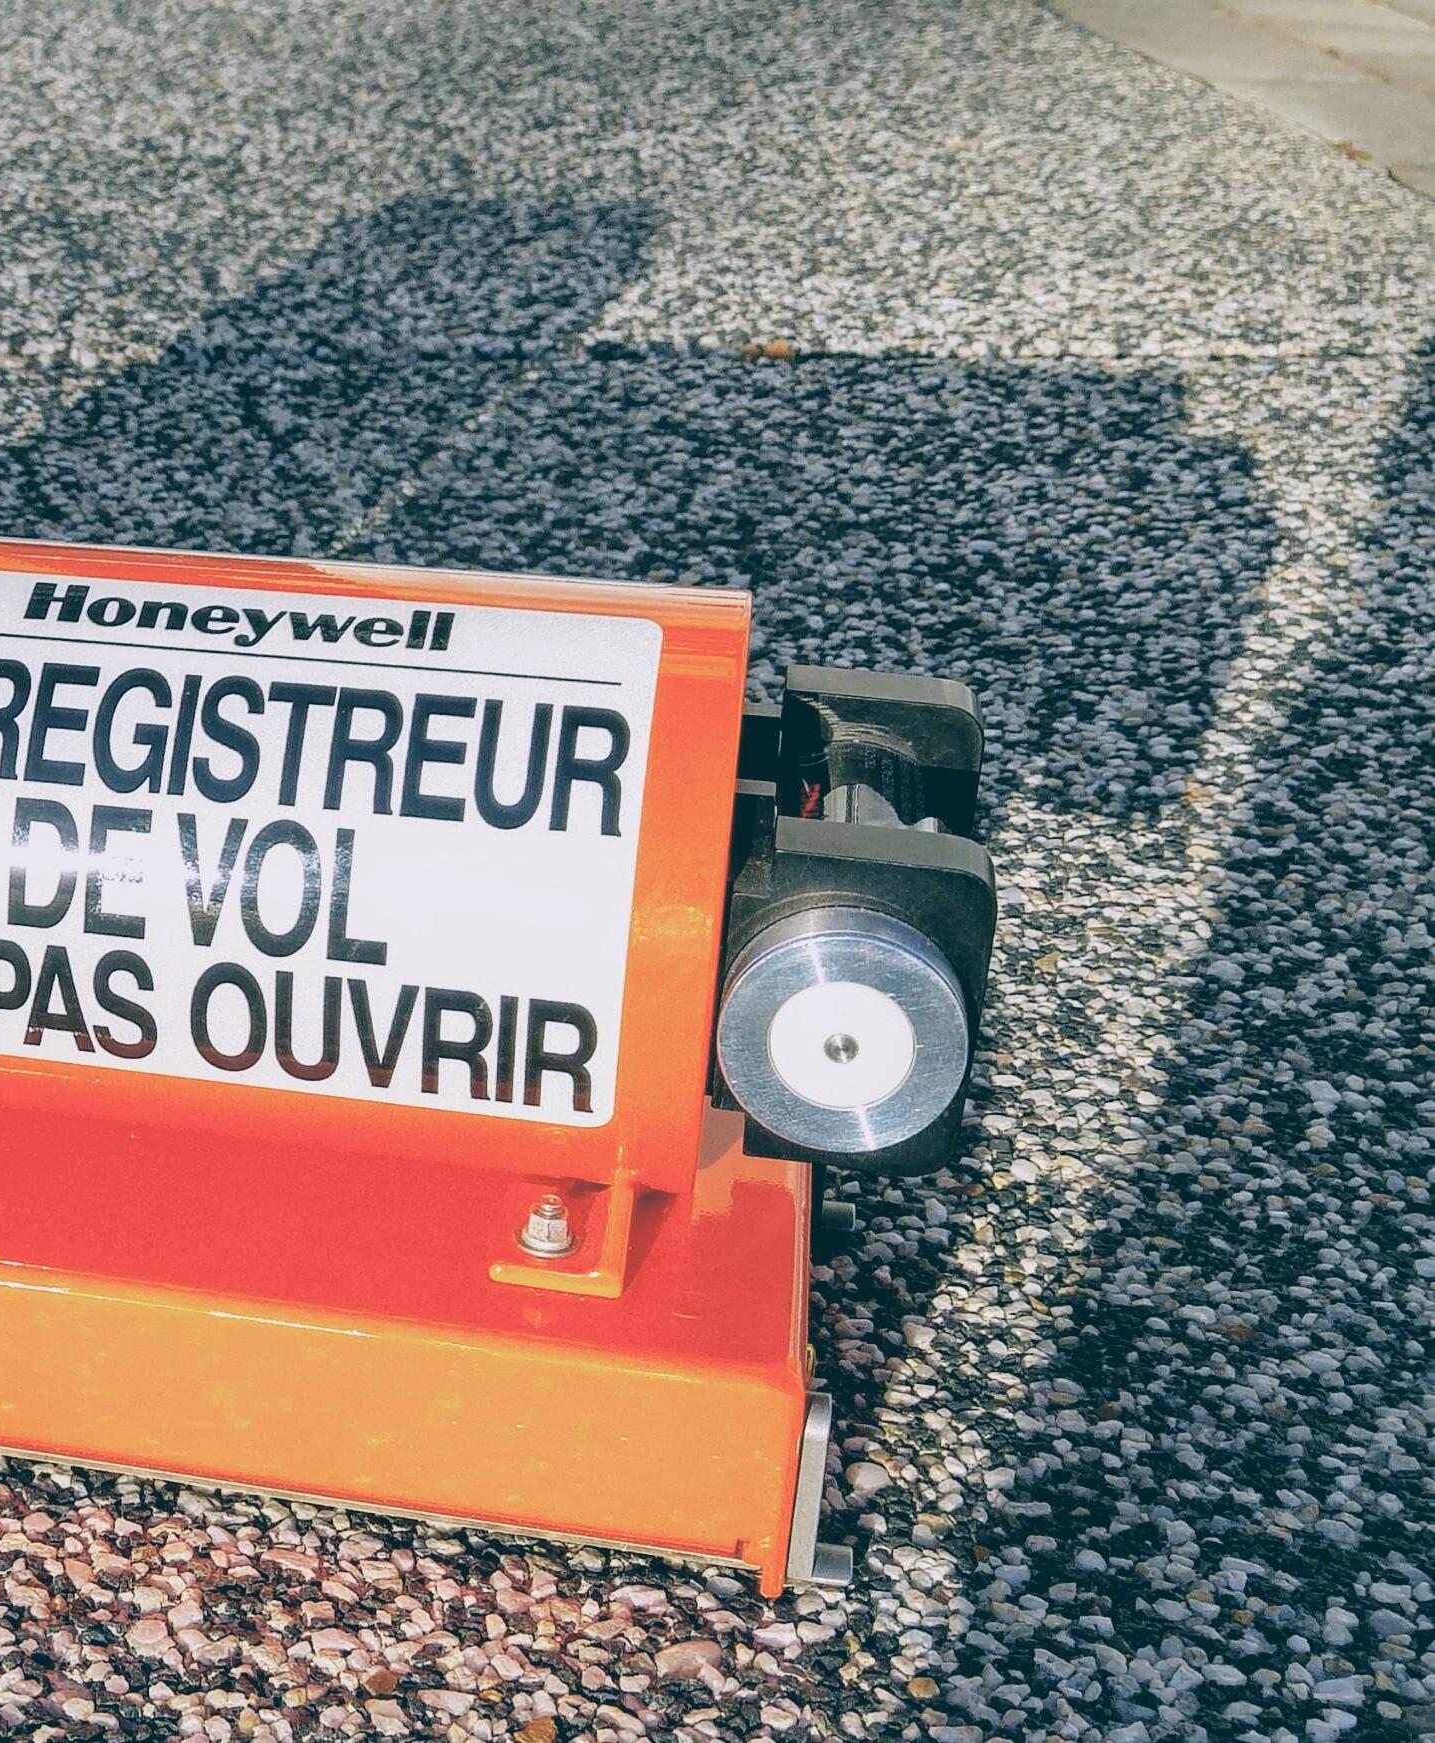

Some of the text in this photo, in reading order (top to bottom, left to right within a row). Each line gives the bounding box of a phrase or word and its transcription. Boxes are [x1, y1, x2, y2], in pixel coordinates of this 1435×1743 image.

[23, 582, 455, 651] Honeywell
[5, 797, 388, 966] DE VOL
[189, 961, 597, 1114] OUVRIR
